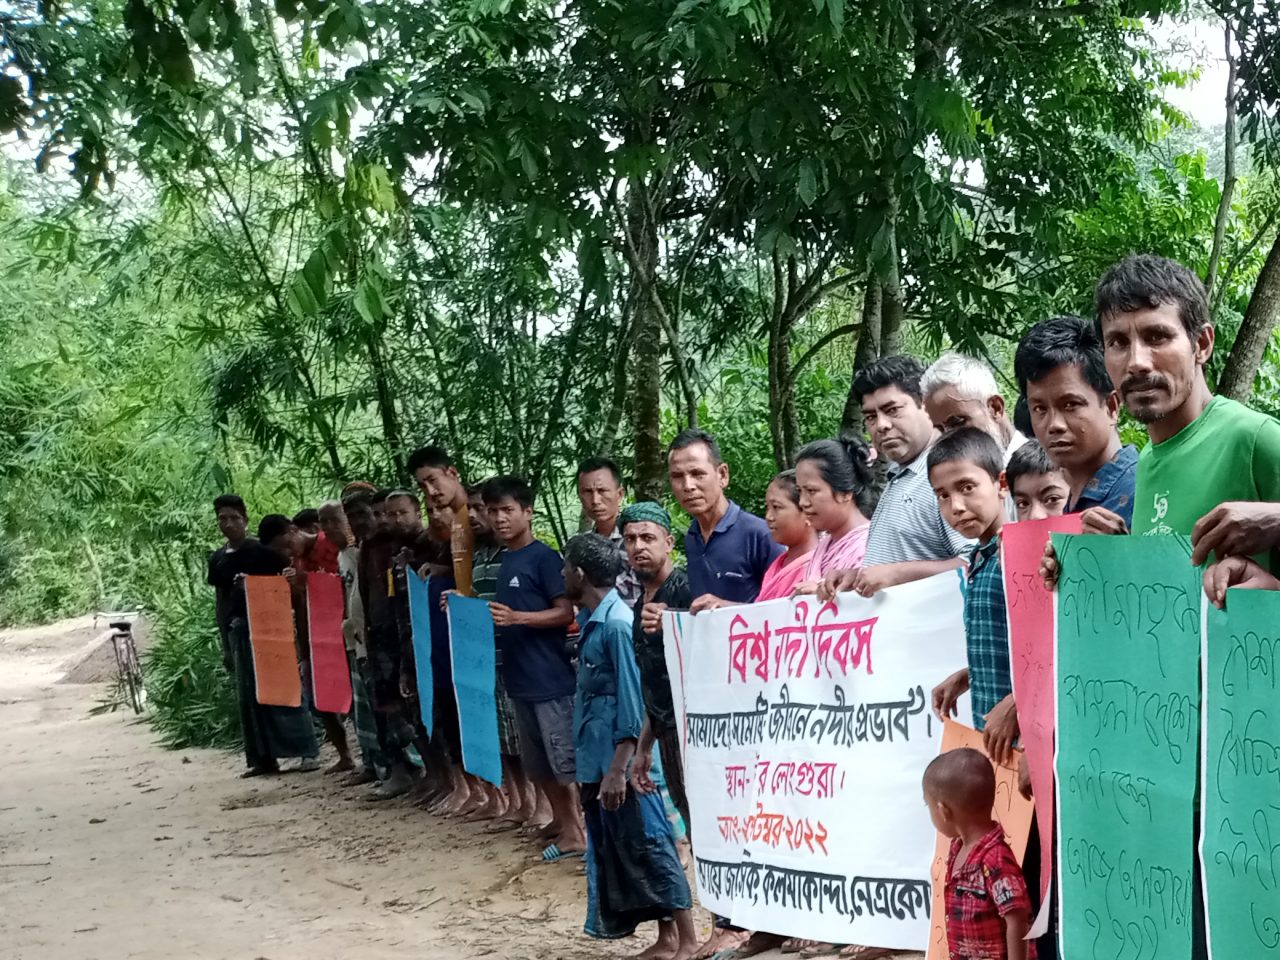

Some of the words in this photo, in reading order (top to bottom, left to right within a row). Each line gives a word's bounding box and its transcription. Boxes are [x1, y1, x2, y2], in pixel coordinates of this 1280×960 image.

[728, 614, 771, 684] বিশ্ব
[812, 601, 880, 679] দিবস
[686, 712, 731, 751] আমাদে
[852, 876, 932, 921] নেত্রকো
